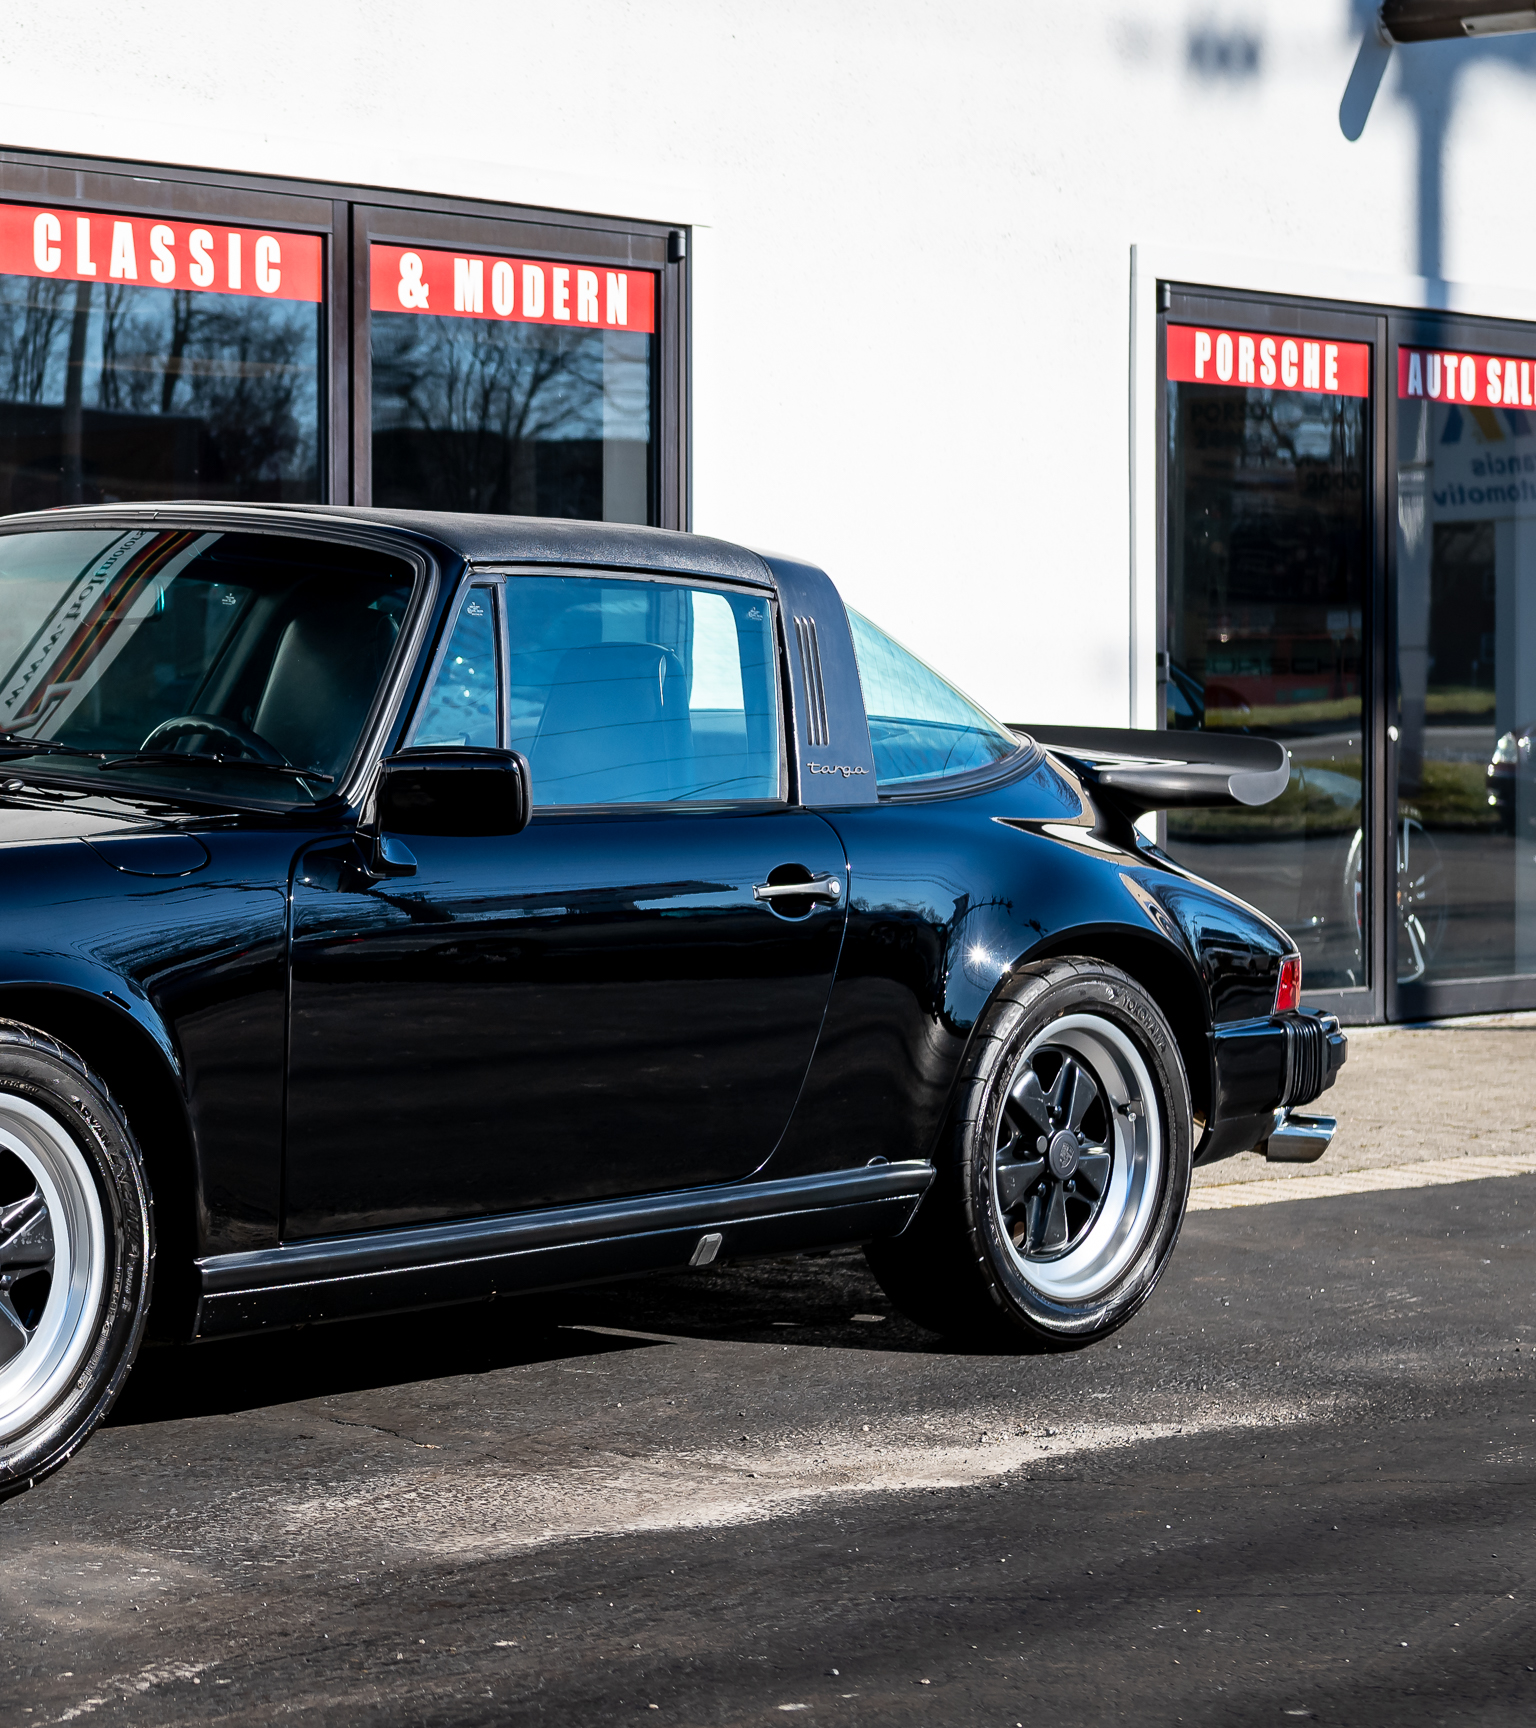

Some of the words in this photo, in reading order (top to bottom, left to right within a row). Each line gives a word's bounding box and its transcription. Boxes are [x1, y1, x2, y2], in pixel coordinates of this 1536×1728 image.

[33, 212, 281, 294] CLASSIC
[397, 252, 430, 309] &
[454, 257, 628, 326] MODERN
[1194, 331, 1339, 391] PORSCHE
[1407, 352, 1476, 402] AUTO
[1486, 357, 1536, 406] SAL
[806, 761, 869, 779] targa
